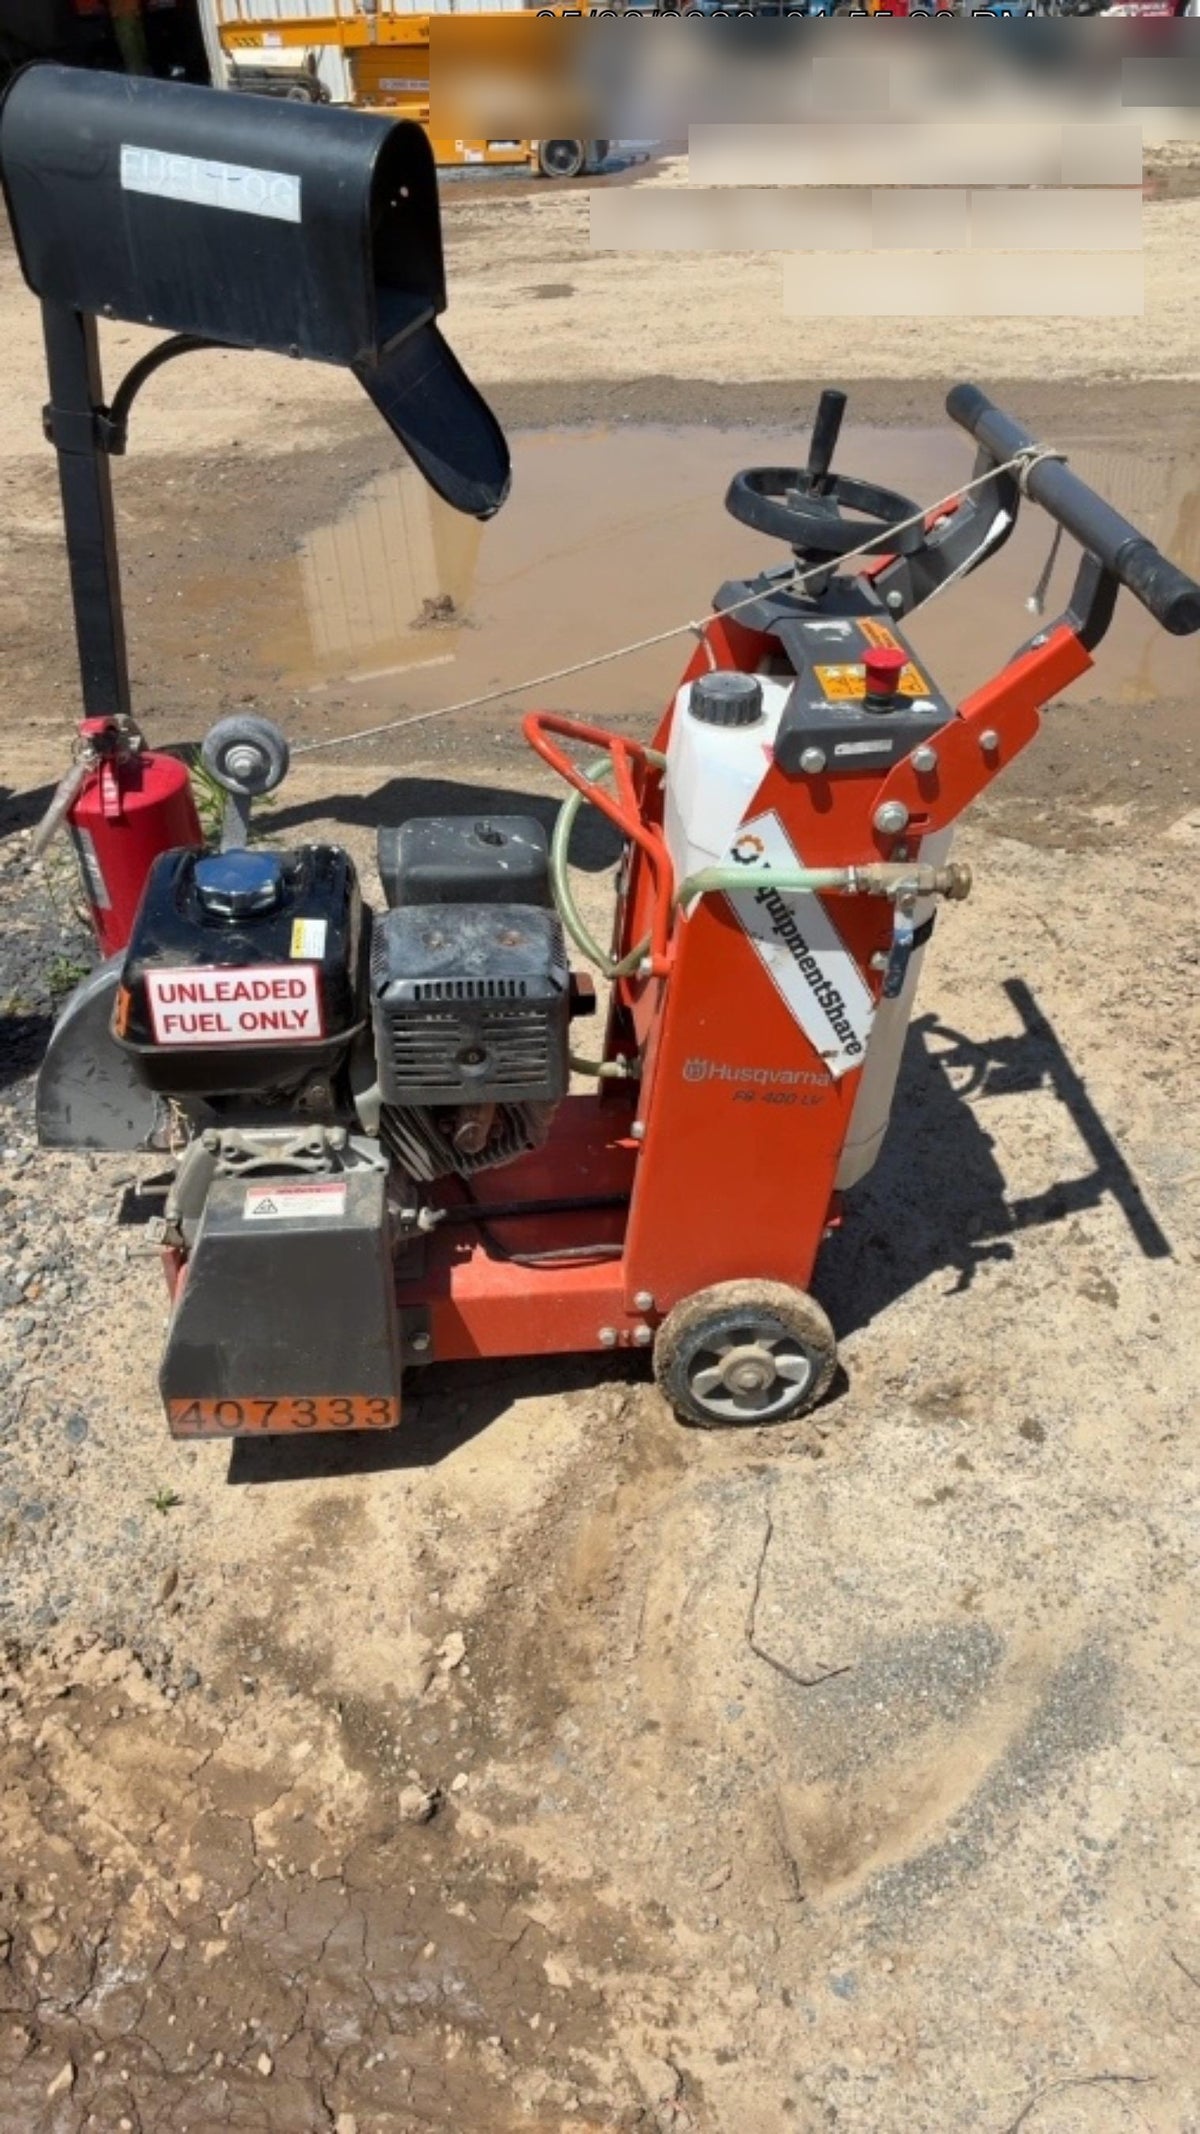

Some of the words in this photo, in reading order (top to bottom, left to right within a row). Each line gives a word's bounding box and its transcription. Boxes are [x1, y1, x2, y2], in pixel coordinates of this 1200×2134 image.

[754, 862, 862, 1056] quipmentShare
[157, 979, 307, 1004] UNLEADED
[163, 1013, 233, 1034] FUEL
[239, 1010, 309, 1032] ONLY
[708, 1062, 831, 1087] Husqvarna
[762, 1091, 798, 1105] 400
[176, 1398, 392, 1431] 407333
